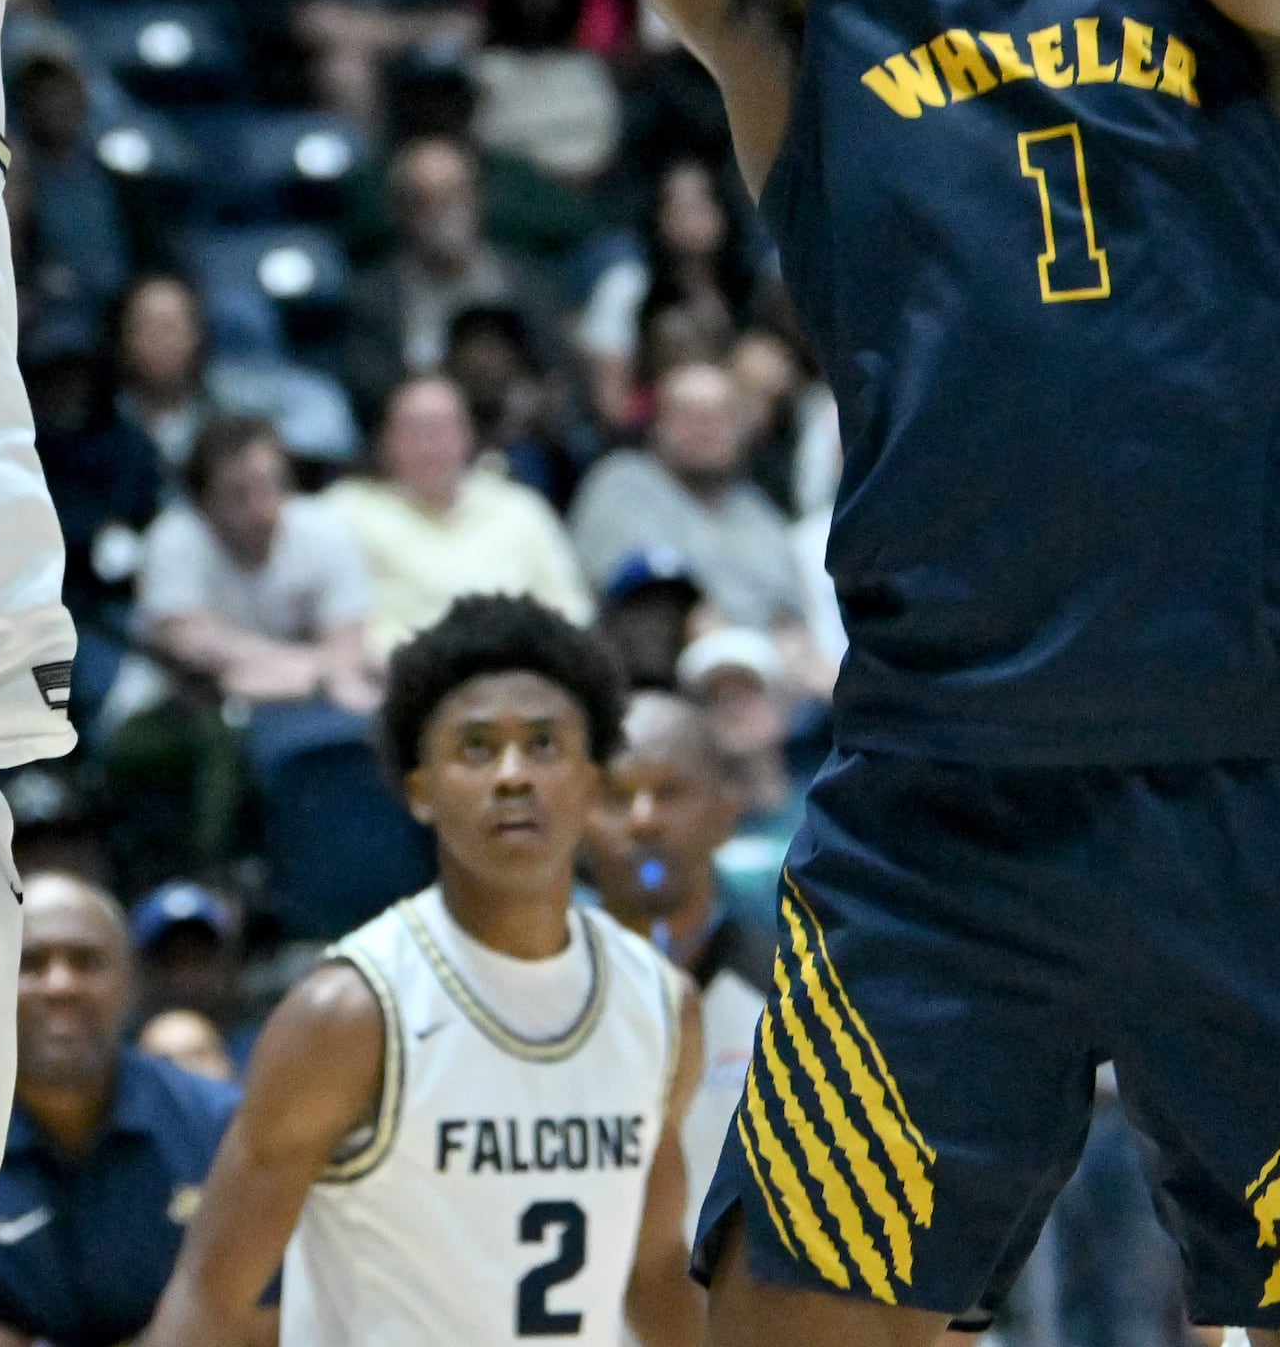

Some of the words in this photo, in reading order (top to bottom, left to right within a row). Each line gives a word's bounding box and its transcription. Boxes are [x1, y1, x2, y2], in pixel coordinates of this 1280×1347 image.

[860, 17, 1201, 119] WHEELER
[1017, 122, 1111, 303] 1
[436, 1115, 644, 1173] FALCONS
[516, 1200, 587, 1337] 2
